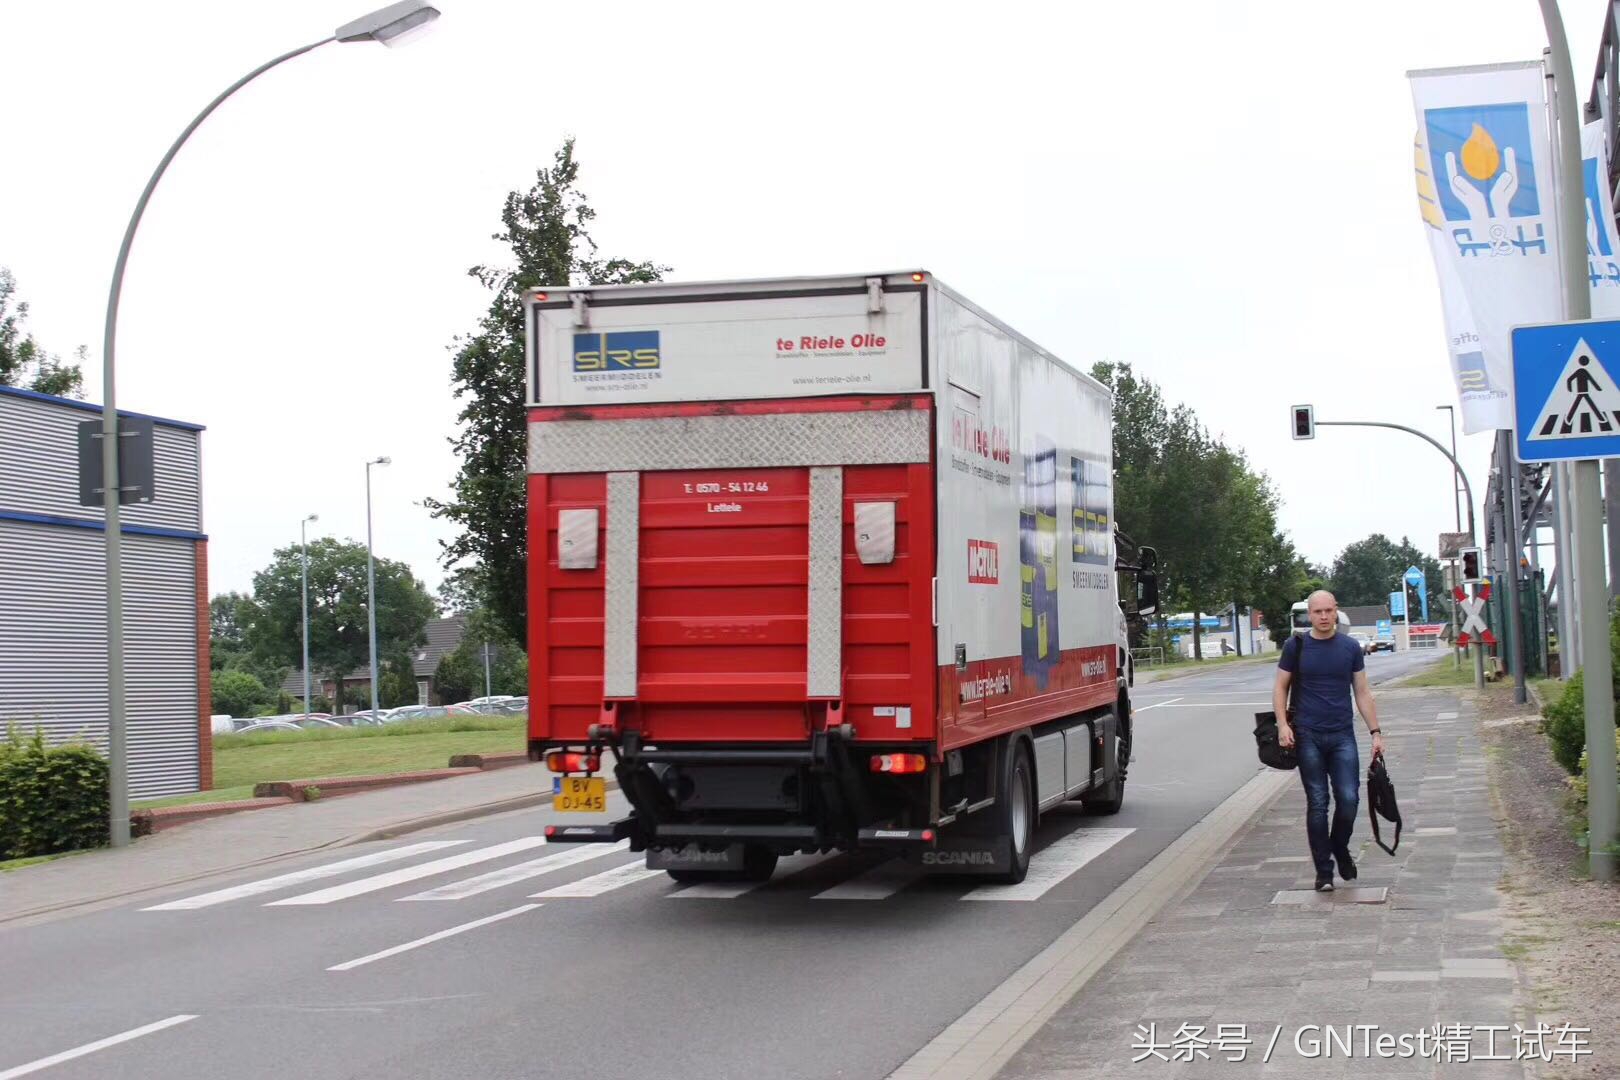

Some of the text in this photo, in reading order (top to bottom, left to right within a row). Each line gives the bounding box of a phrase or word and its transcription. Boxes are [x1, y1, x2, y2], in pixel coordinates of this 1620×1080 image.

[776, 333, 887, 350] te Riele Olie
[743, 482, 755, 492] 12
[573, 780, 590, 793] BV
[922, 851, 995, 865] SCANIA
